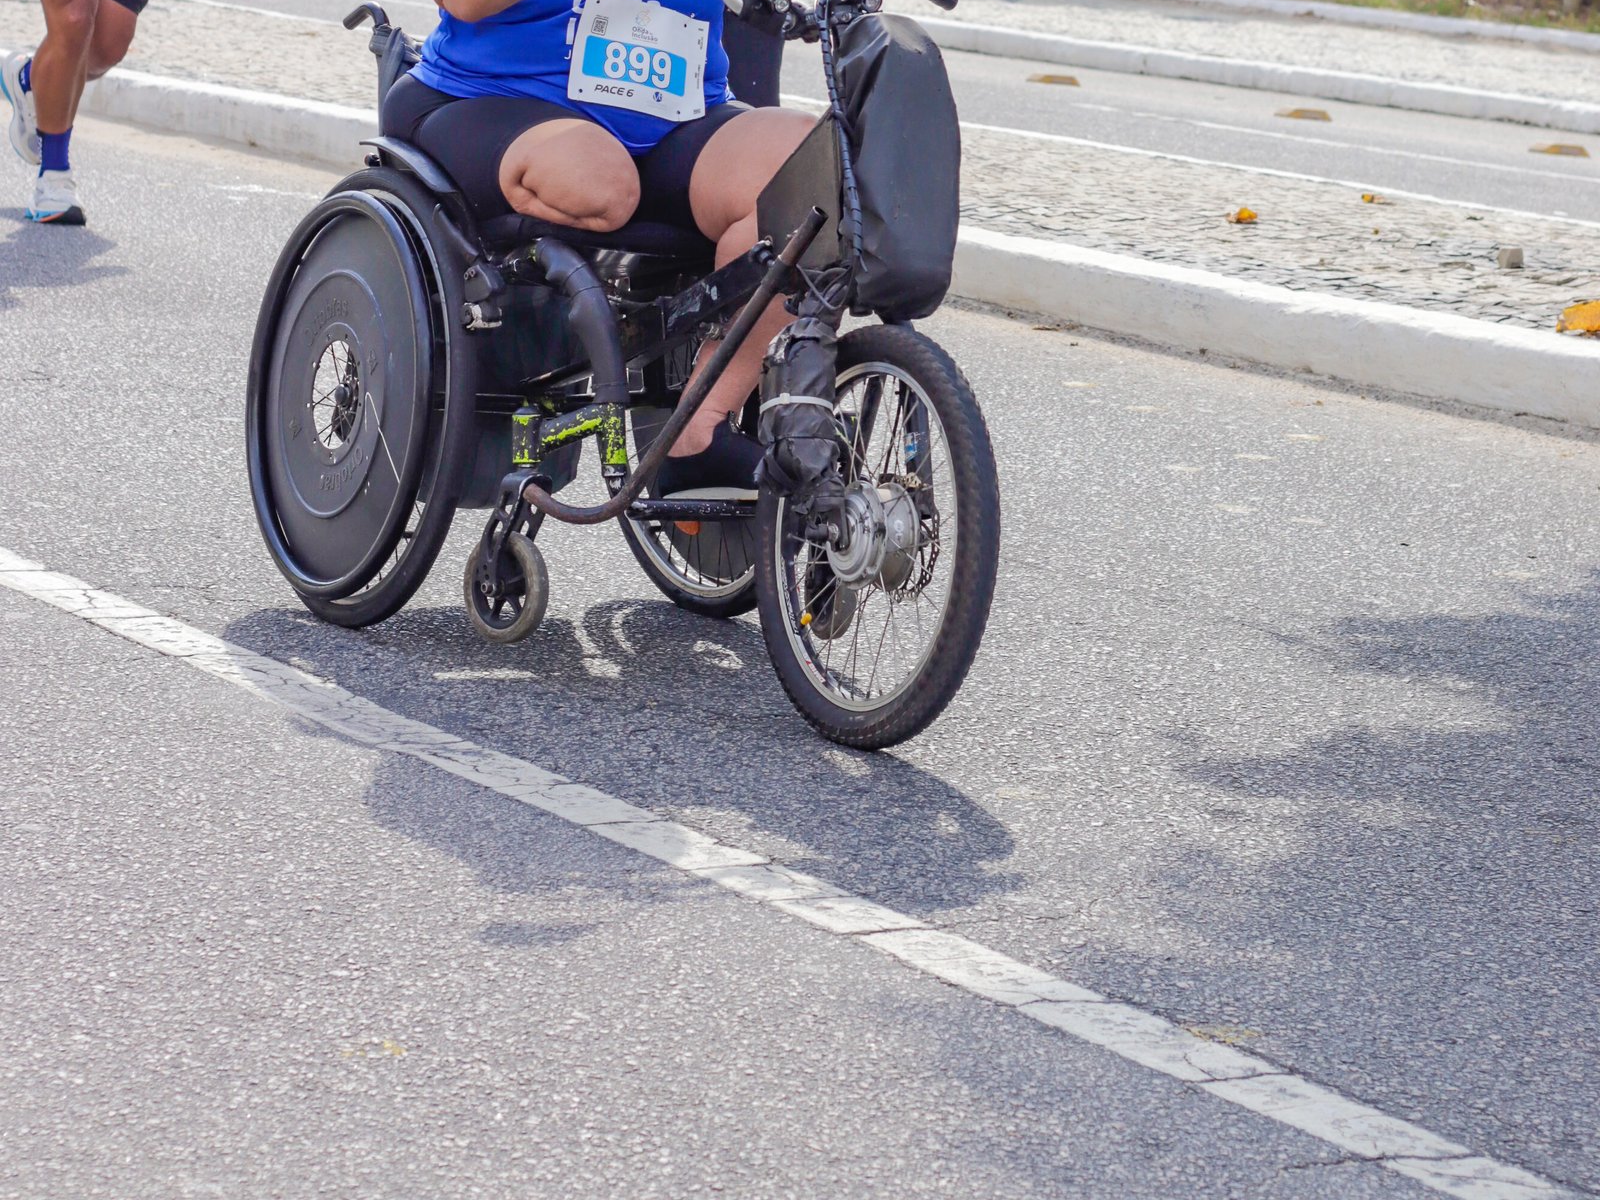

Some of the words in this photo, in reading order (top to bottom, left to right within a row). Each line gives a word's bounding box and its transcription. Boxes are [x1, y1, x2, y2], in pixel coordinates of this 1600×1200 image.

[603, 41, 672, 90] 899
[594, 84, 626, 96] PACE
[626, 88, 635, 98] 6
